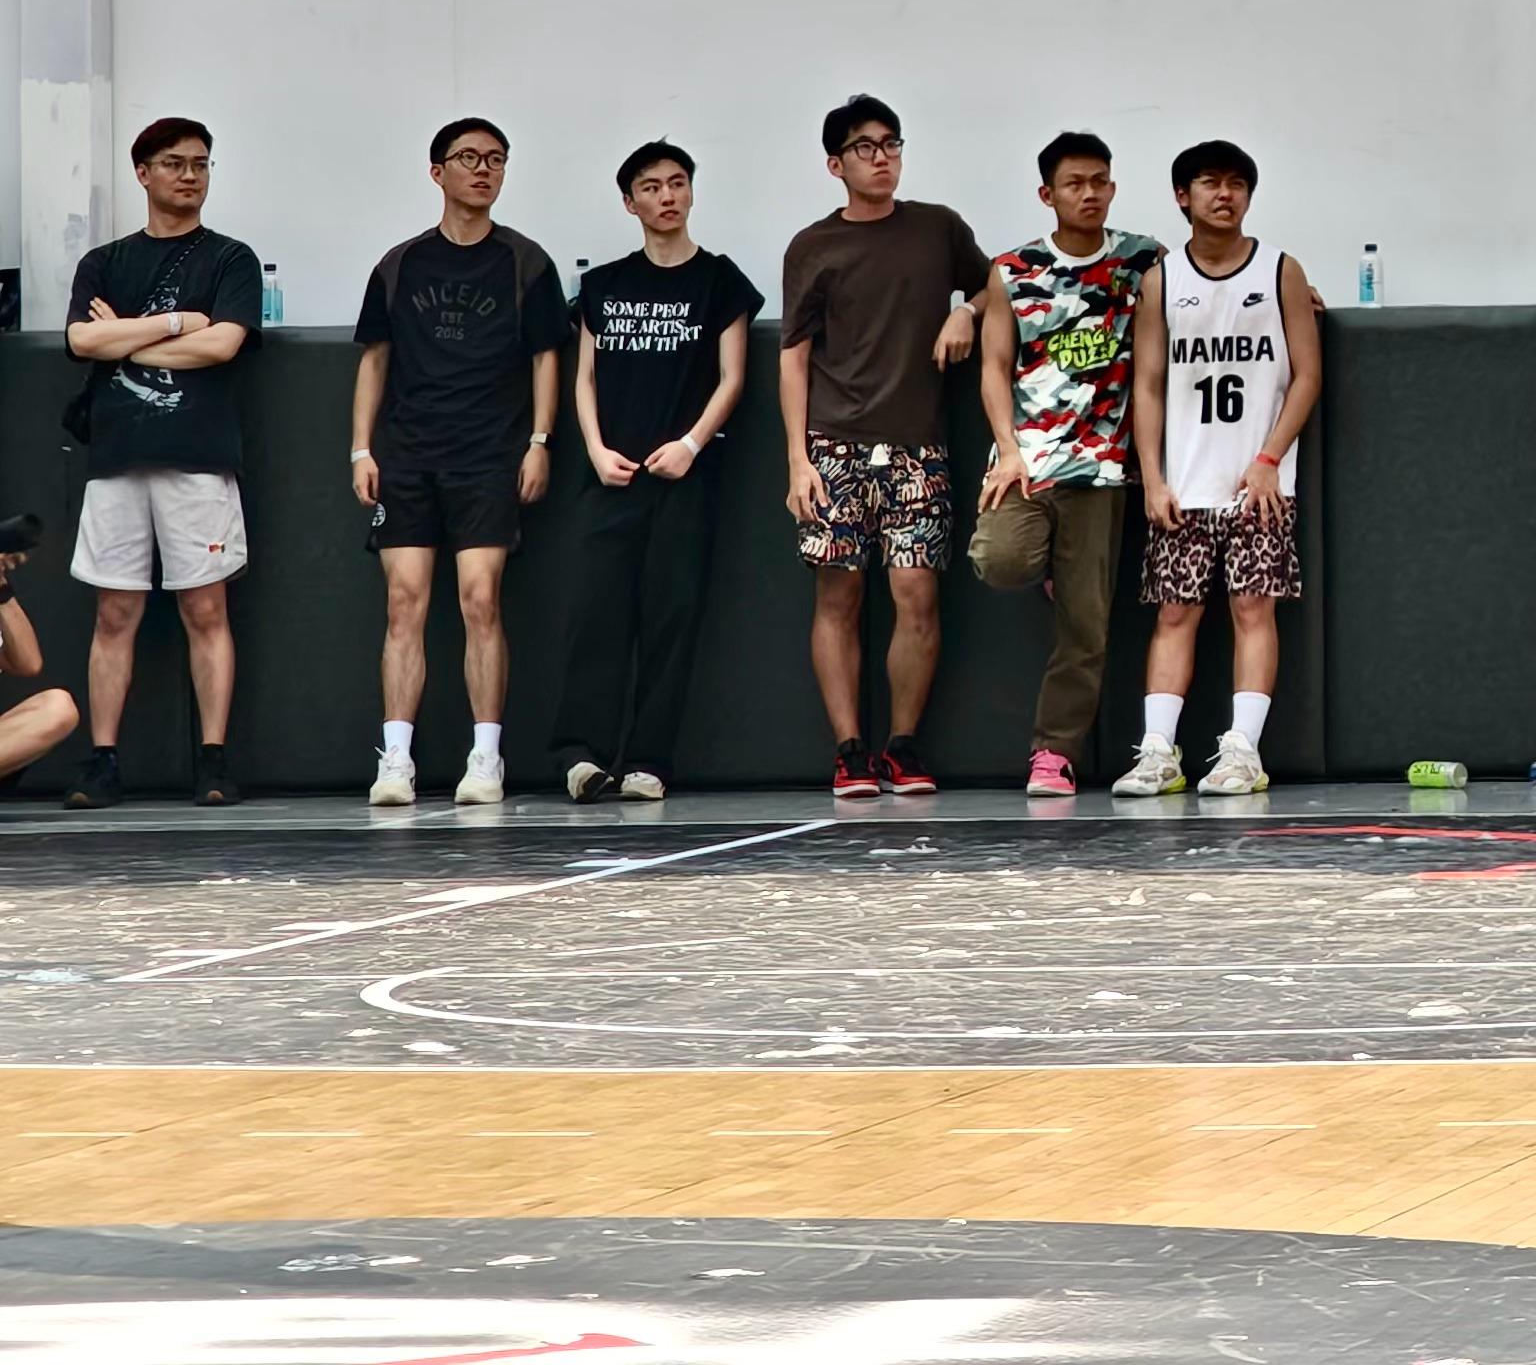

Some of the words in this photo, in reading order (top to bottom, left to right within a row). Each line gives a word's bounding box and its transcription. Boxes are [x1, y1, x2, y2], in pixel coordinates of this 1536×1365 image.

[603, 301, 650, 317] SOME
[604, 319, 637, 334] ARE
[626, 336, 652, 351] AM
[1172, 335, 1275, 364] MAMBA
[1194, 374, 1245, 425] 16
